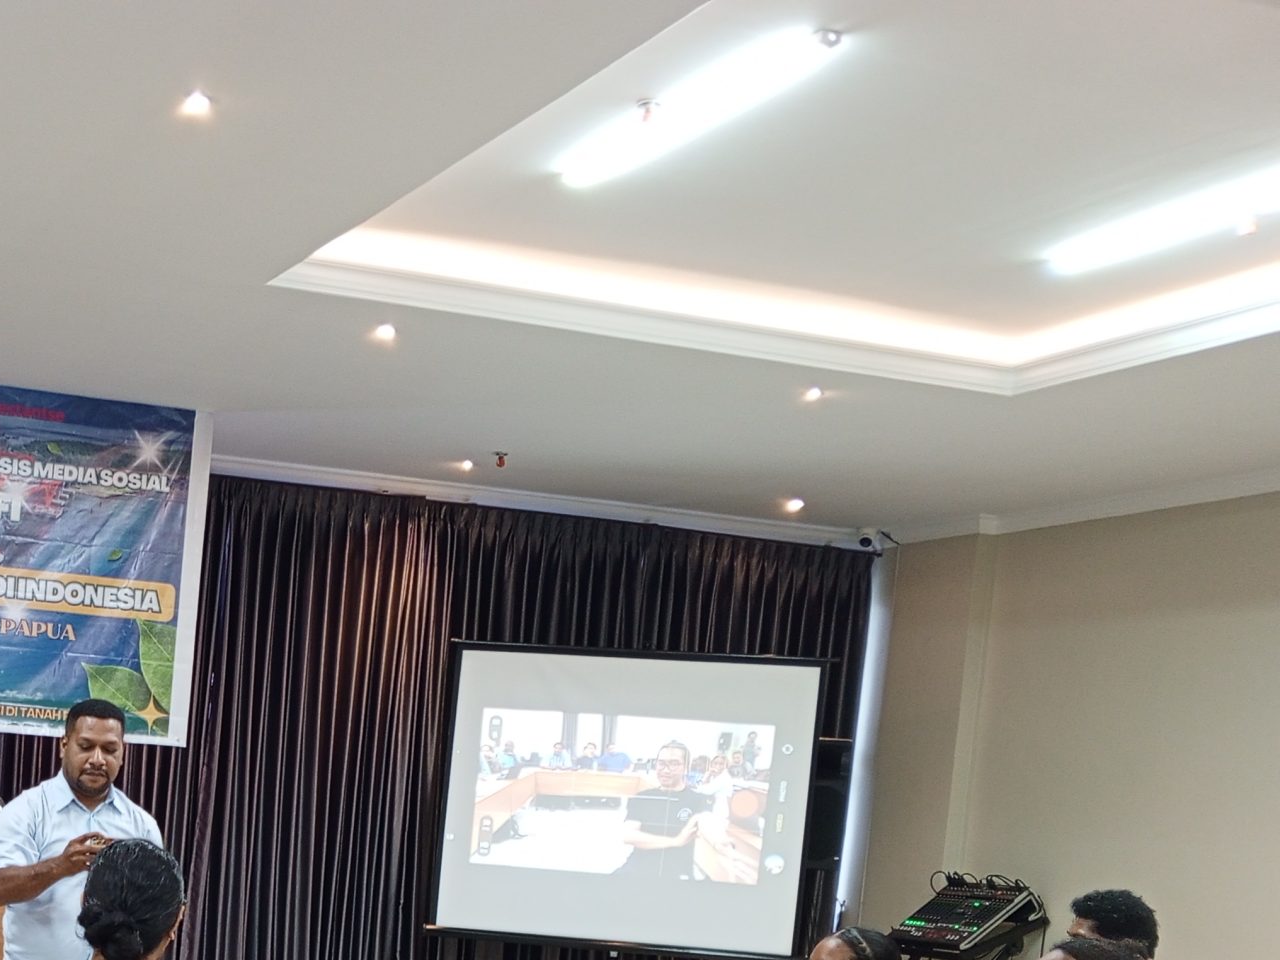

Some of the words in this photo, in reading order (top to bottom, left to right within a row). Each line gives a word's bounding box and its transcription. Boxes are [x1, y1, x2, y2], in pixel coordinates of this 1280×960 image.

[33, 463, 99, 486] MEDIA
[98, 468, 171, 493] SOSIAL
[15, 578, 162, 614] INDONESIA
[0, 618, 76, 641] PAPUA
[5, 705, 18, 717] DI
[21, 707, 61, 721] TANAH
